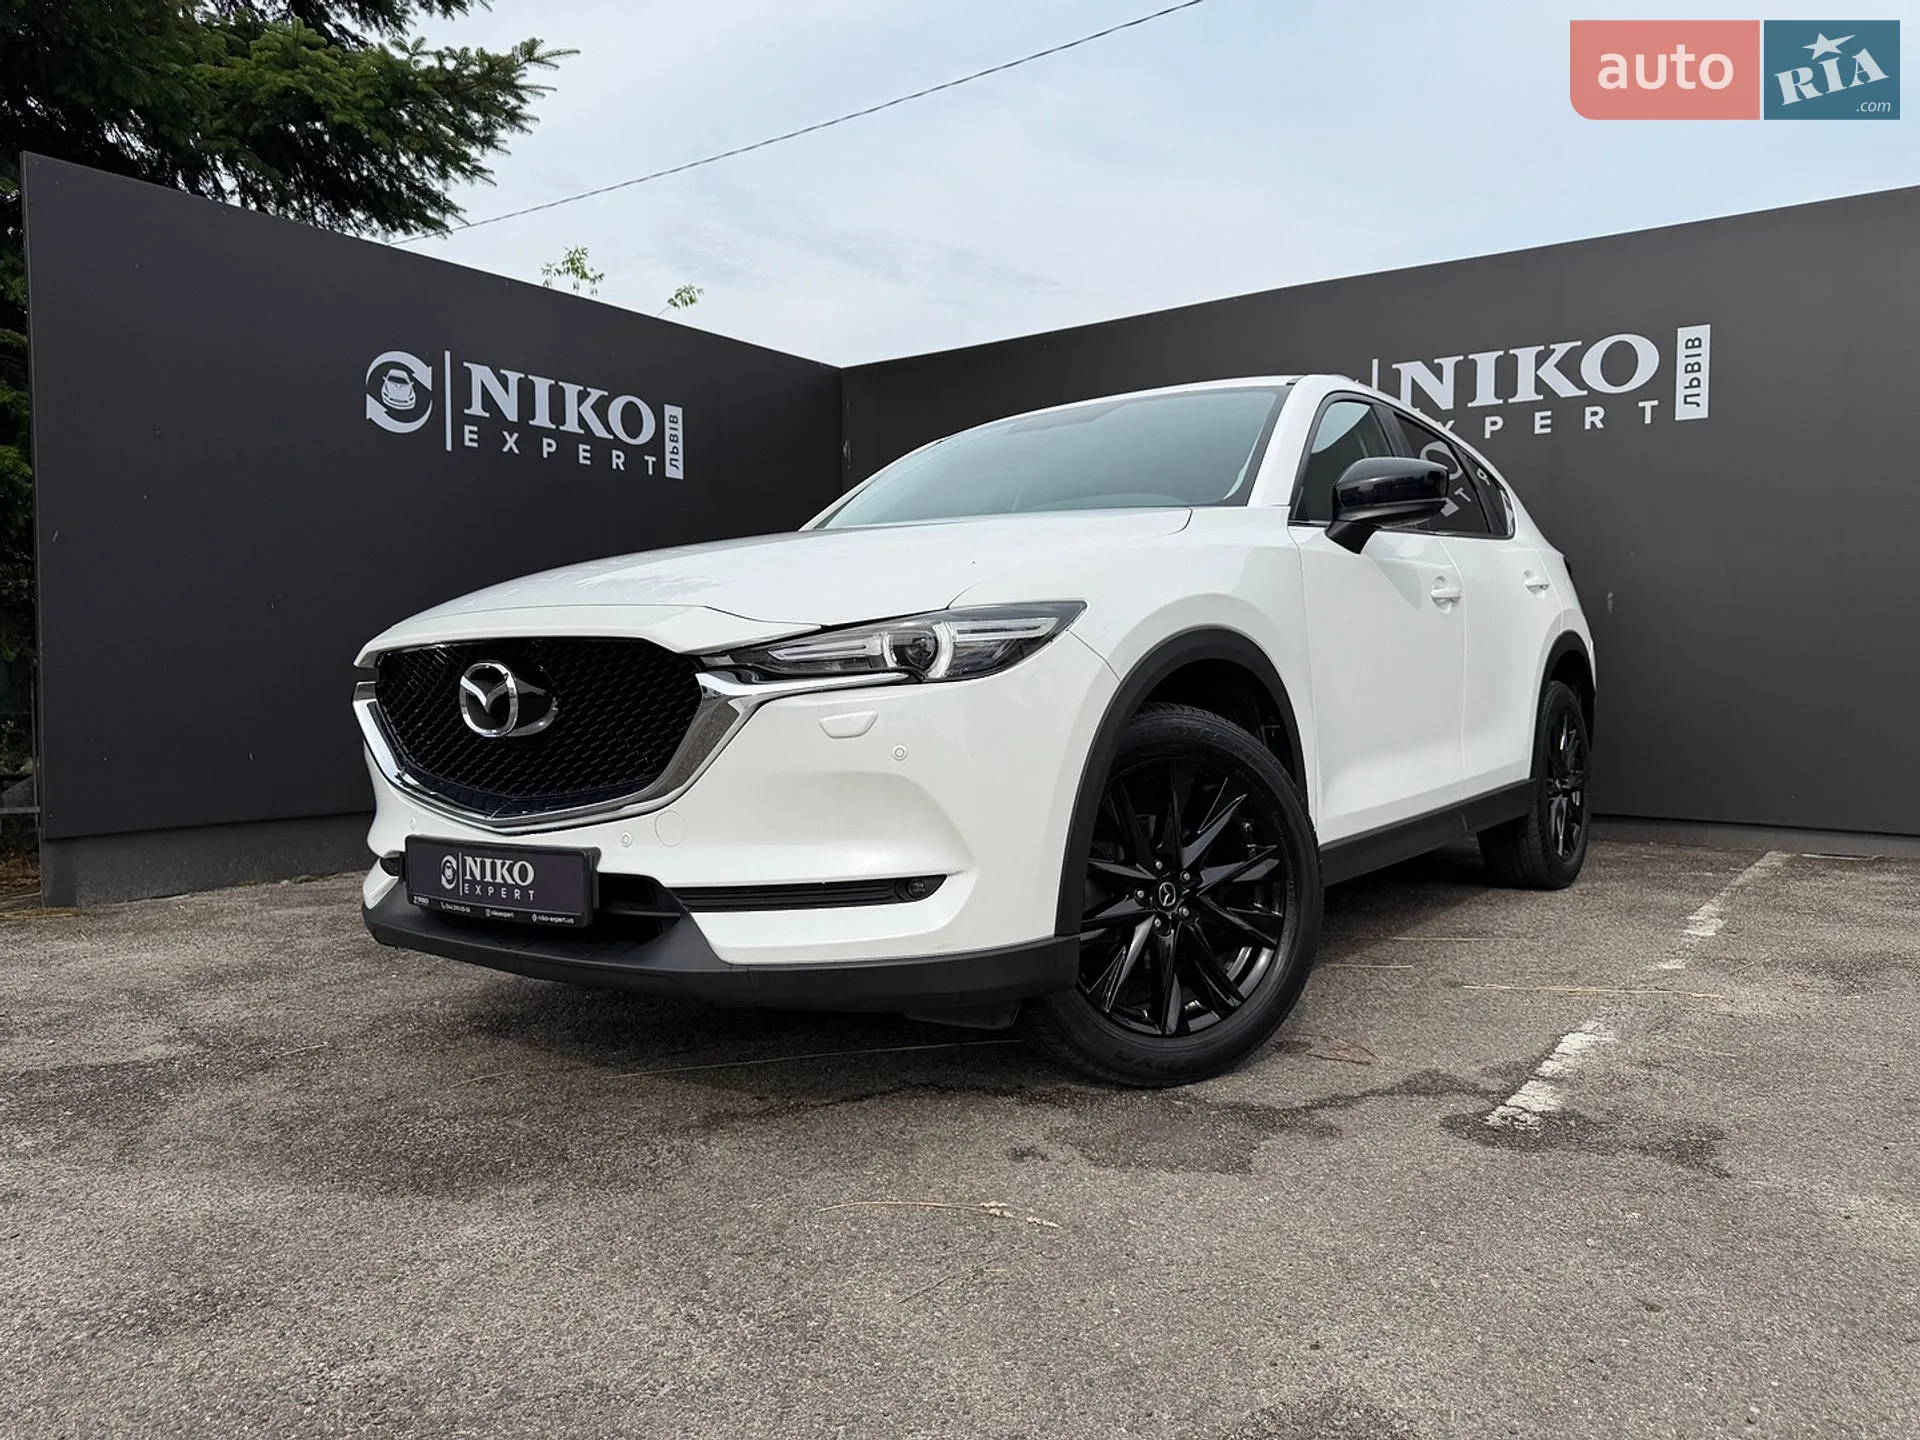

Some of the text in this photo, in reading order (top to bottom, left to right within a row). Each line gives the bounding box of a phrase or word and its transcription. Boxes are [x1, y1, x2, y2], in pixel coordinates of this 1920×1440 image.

[1392, 333, 1660, 411] NIKO
[1683, 335, 1702, 408] ЛЬВІВ
[463, 361, 656, 445] NIKO
[1437, 400, 1659, 439] PERT
[463, 424, 656, 475] EXPERT
[668, 413, 681, 470] ЛЬВІВ
[463, 856, 535, 886] NIKO
[463, 883, 535, 901] EXPERT
